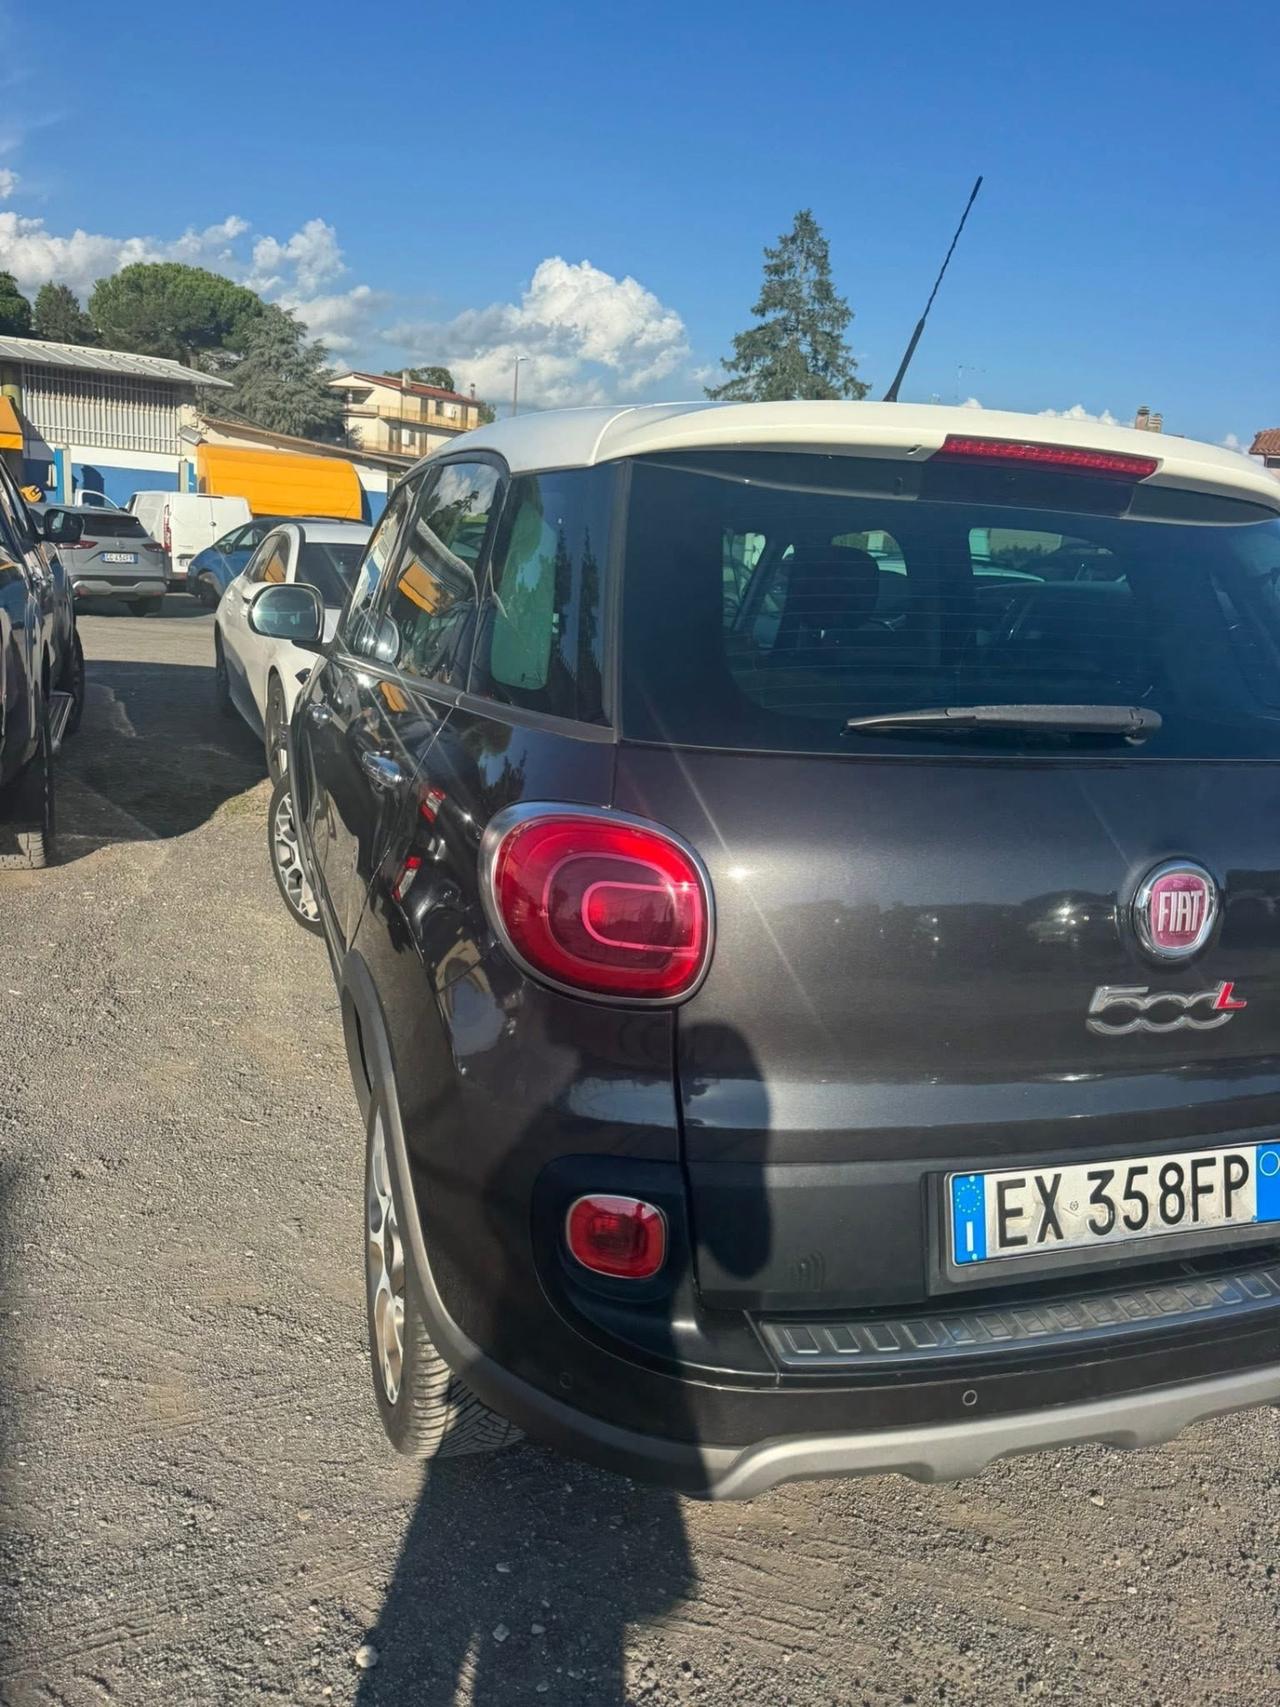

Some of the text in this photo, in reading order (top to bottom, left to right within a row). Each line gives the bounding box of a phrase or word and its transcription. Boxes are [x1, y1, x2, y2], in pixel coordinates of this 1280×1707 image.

[1157, 890, 1203, 932] FIAT
[997, 1154, 1250, 1248] EX 358FP
[966, 1221, 974, 1252] I
